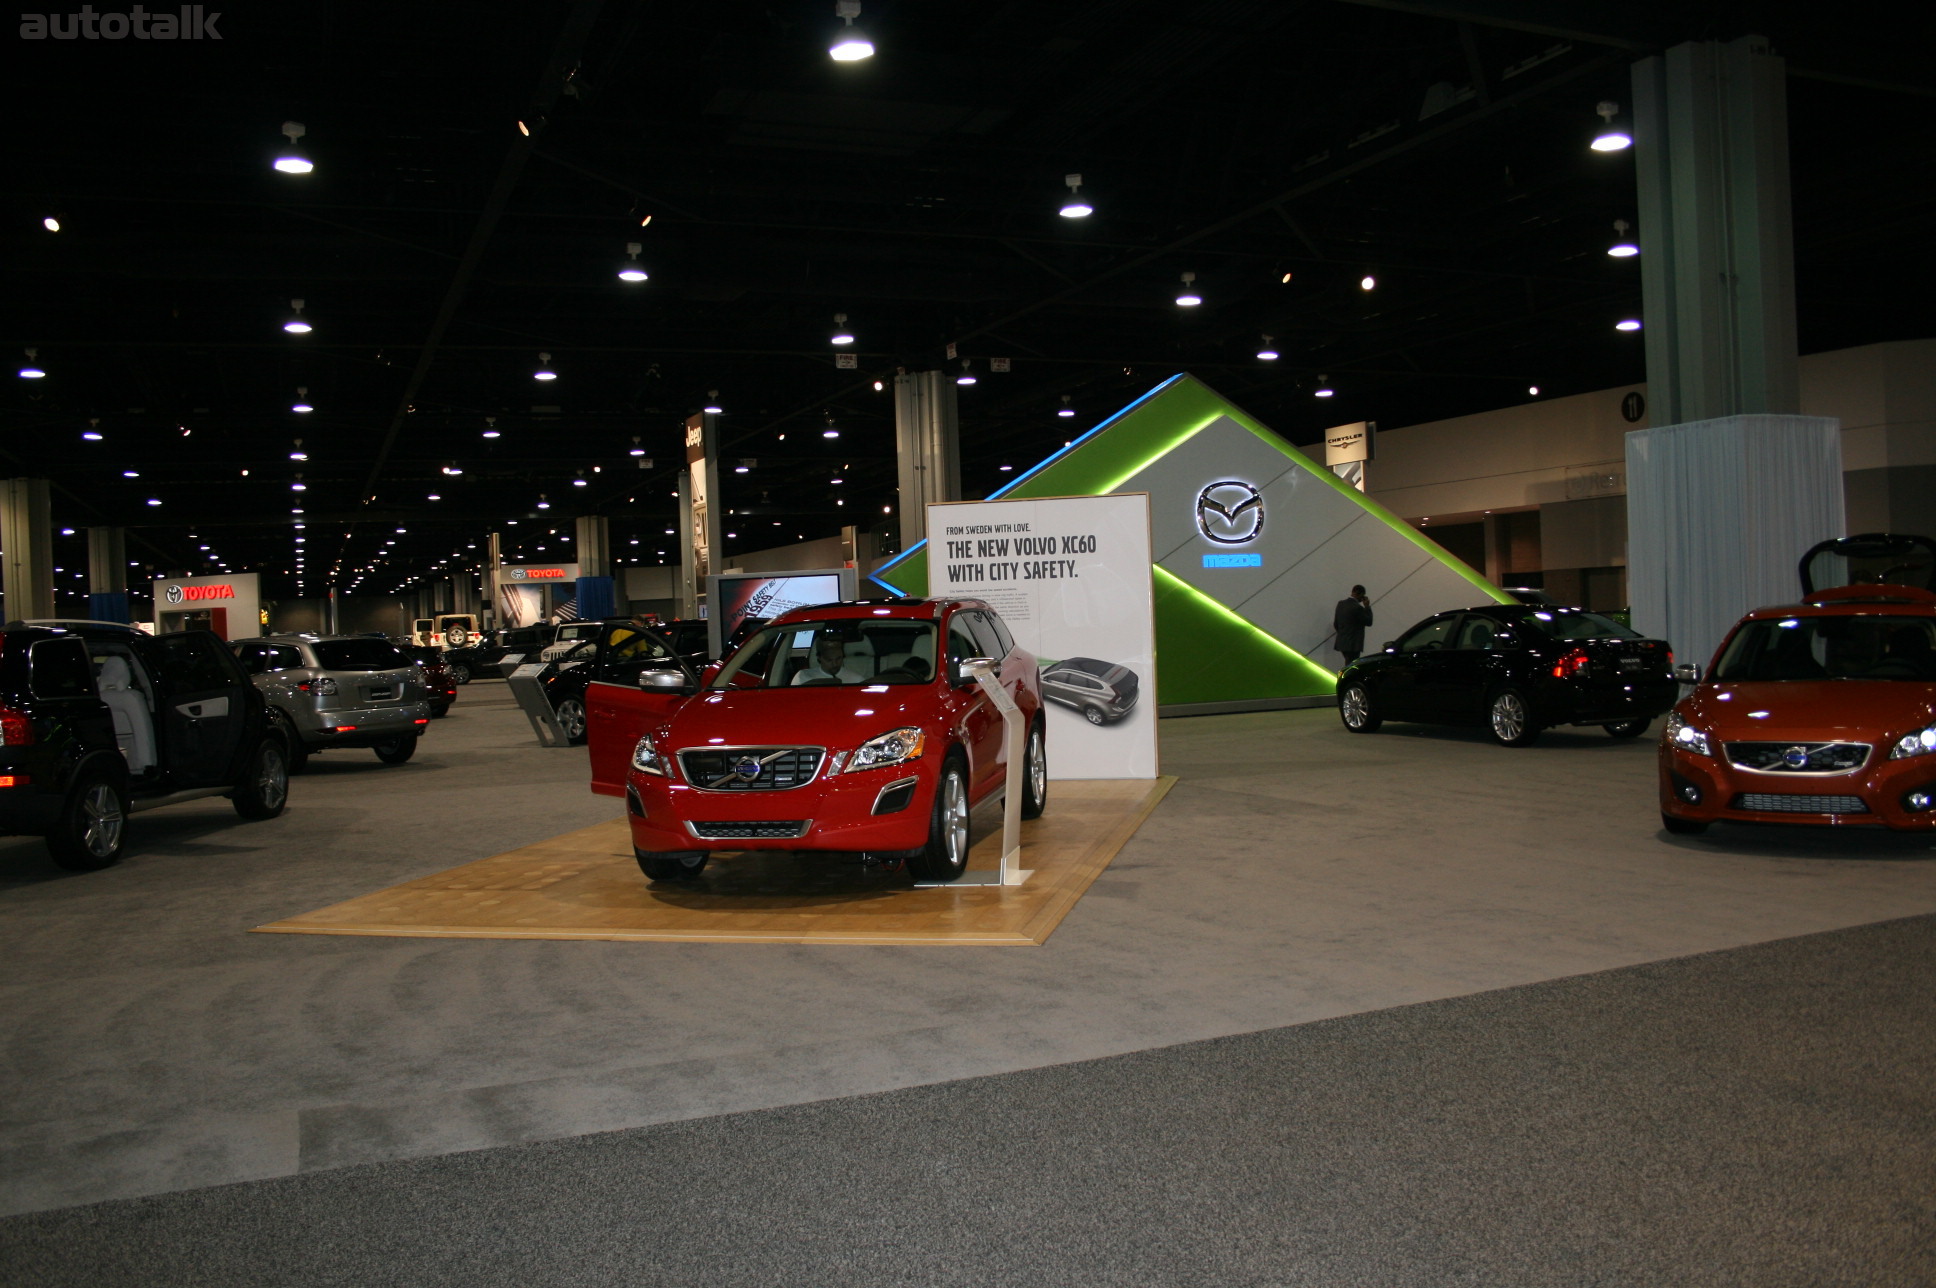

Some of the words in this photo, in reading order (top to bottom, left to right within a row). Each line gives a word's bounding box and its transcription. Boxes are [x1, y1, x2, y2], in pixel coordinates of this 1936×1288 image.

[686, 426, 702, 447] Jeep
[1328, 433, 1363, 444] CHRYSLER
[946, 526, 964, 536] FROM
[965, 525, 993, 535] SWEDEN
[994, 524, 1012, 533] WITH
[1013, 523, 1031, 533] LOVE.
[947, 540, 973, 559] THE
[977, 538, 1009, 558] NEW
[1013, 536, 1057, 556] VOLVO
[1061, 534, 1097, 555] XC60
[526, 568, 567, 579] TOYOTA
[948, 563, 984, 583] WITH
[989, 561, 1018, 581] CITY
[1023, 559, 1079, 580] SAFETY.
[182, 584, 235, 601] TOYOTA
[752, 585, 769, 604] SAFETY
[744, 595, 773, 617] 1959
